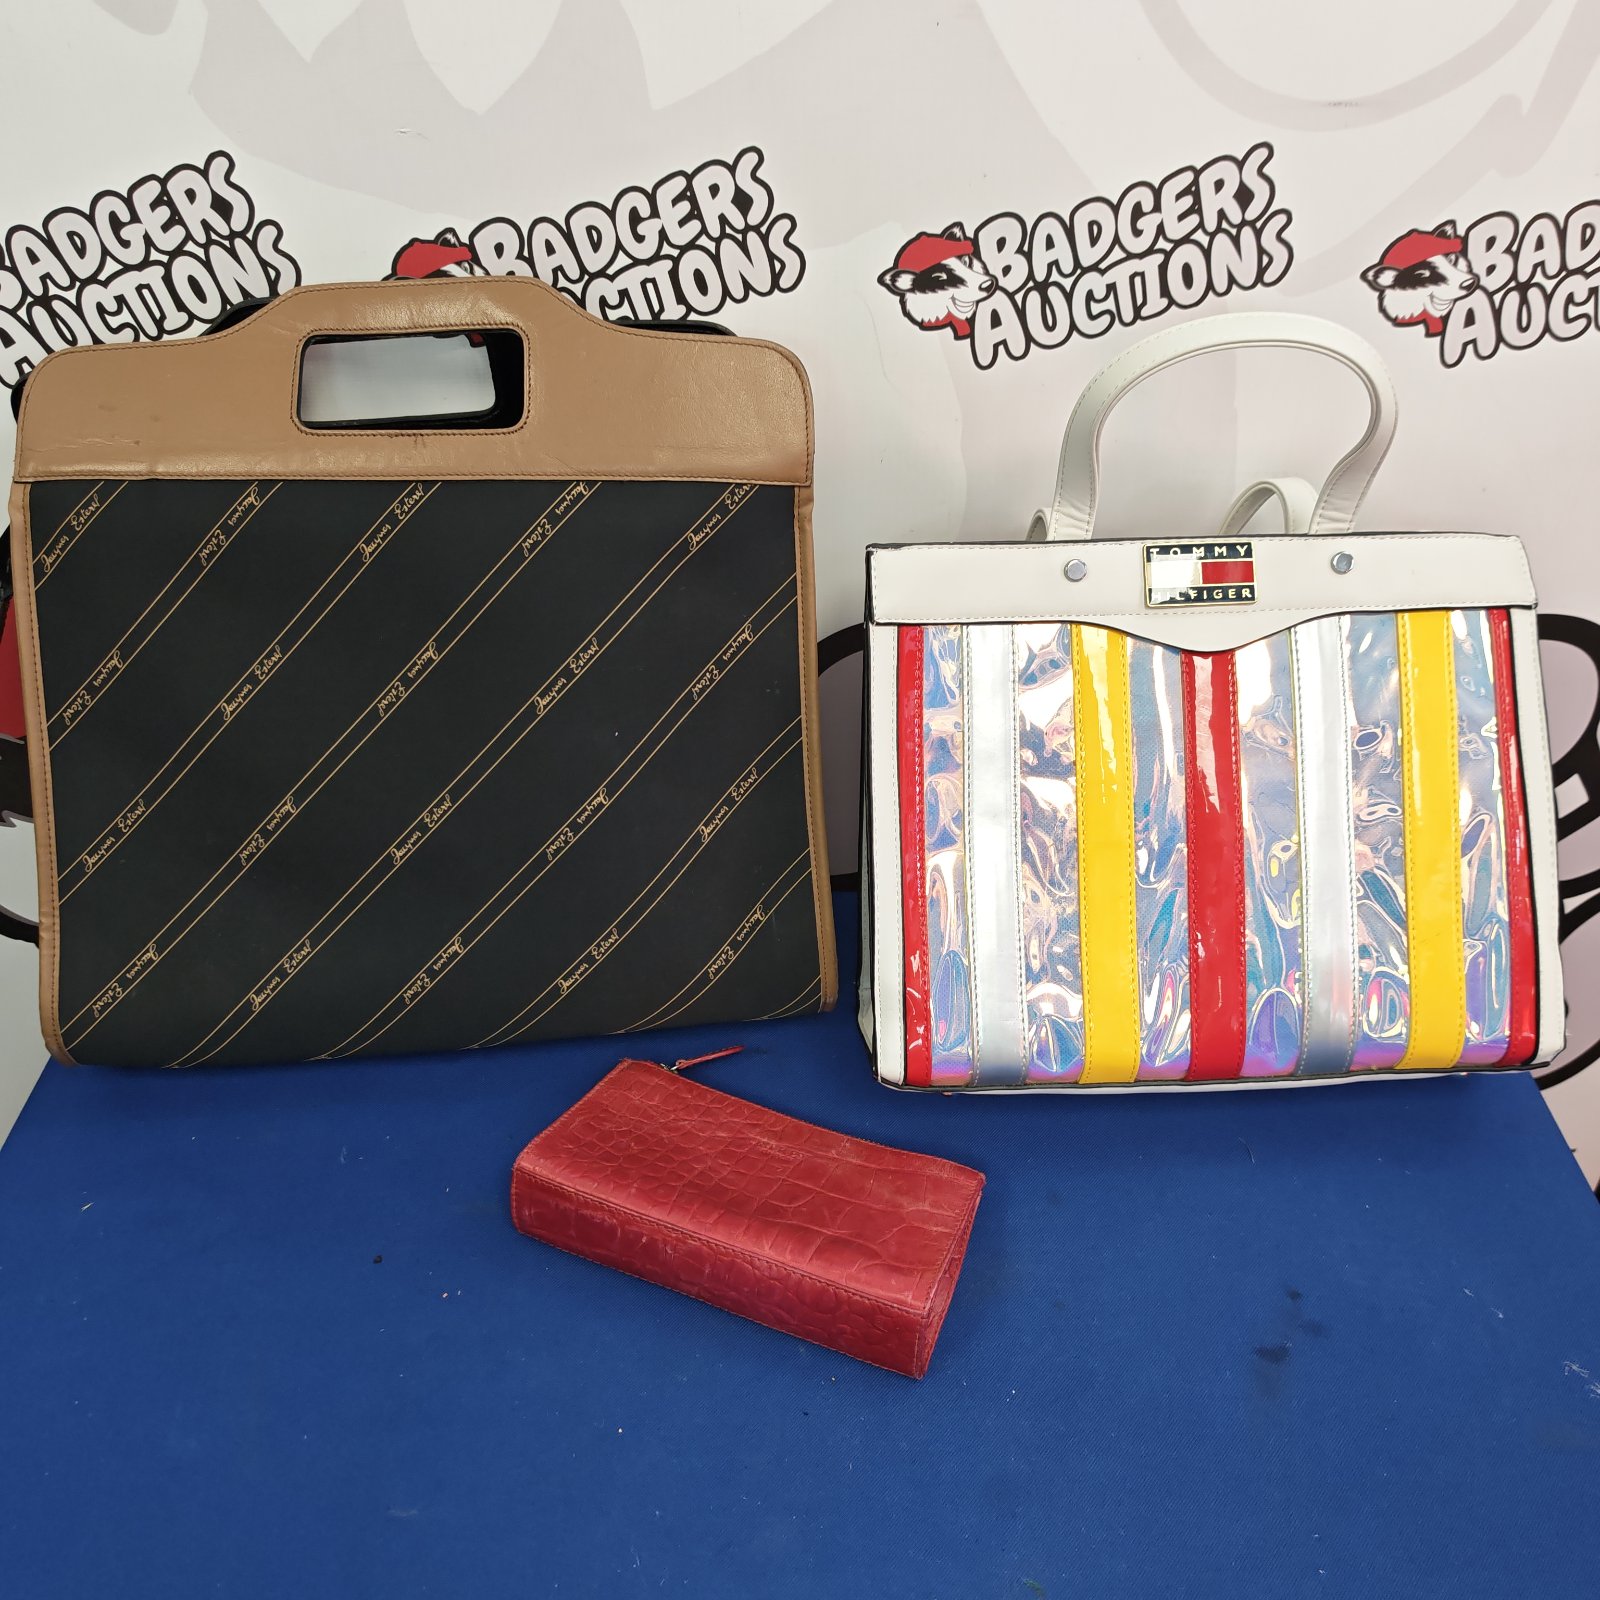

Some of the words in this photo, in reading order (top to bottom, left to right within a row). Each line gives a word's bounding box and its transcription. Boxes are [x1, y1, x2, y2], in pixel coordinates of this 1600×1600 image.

[469, 146, 774, 288] BADGERS
[560, 213, 806, 321] CTIONS
[974, 142, 1275, 296] BADGERS
[970, 209, 1293, 370] AUCTIONS
[725, 484, 754, 510] Ester
[1149, 545, 1248, 559] TOMMY
[1151, 587, 1252, 601] HILFIGER
